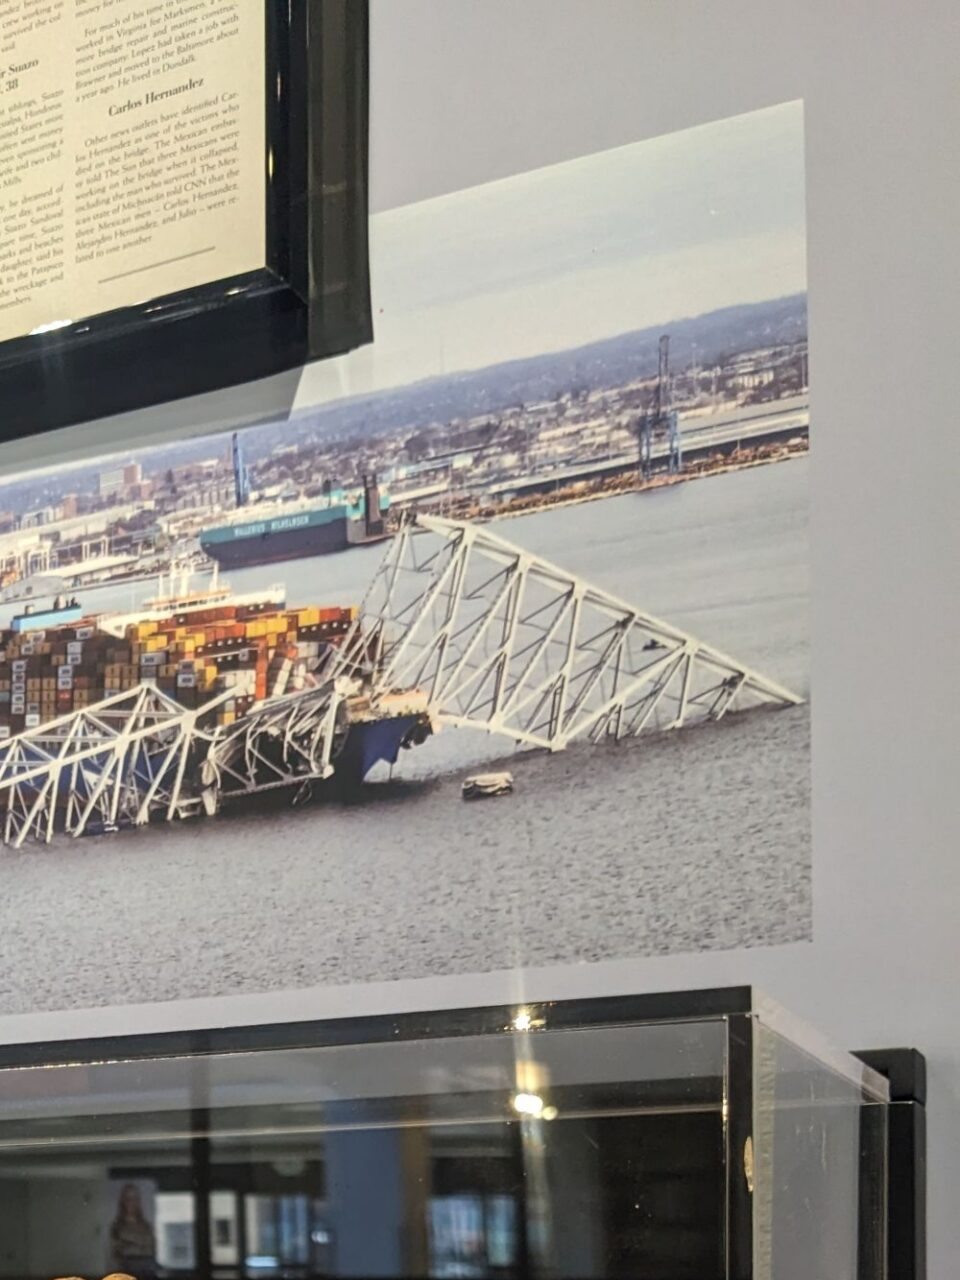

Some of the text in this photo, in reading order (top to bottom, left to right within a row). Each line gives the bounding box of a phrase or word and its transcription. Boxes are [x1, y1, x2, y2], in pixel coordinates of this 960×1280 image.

[8, 59, 39, 76] Suazo
[6, 78, 20, 93] 38
[108, 78, 205, 117] Carlos Hernandez
